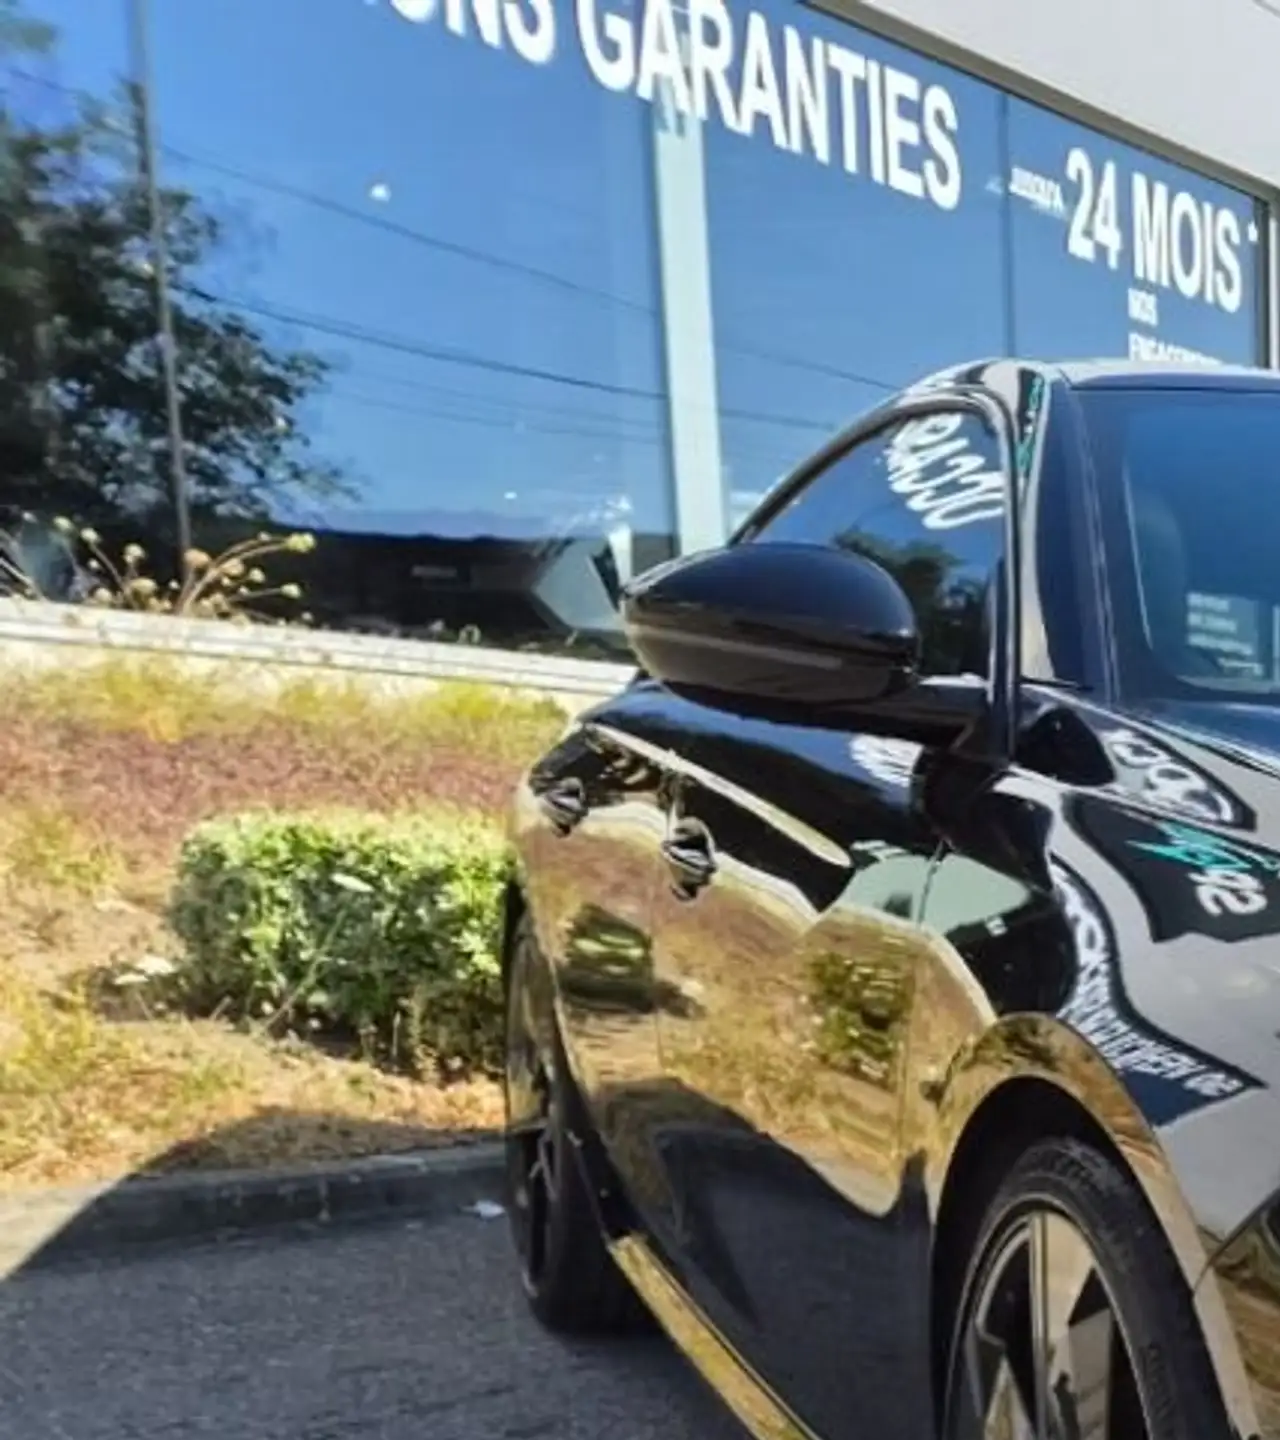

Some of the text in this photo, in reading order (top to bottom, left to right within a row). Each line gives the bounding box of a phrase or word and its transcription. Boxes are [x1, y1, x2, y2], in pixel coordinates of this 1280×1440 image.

[576, 0, 962, 210] GARANTIES
[1066, 147, 1122, 270] 24
[1131, 171, 1242, 313] MOIS
